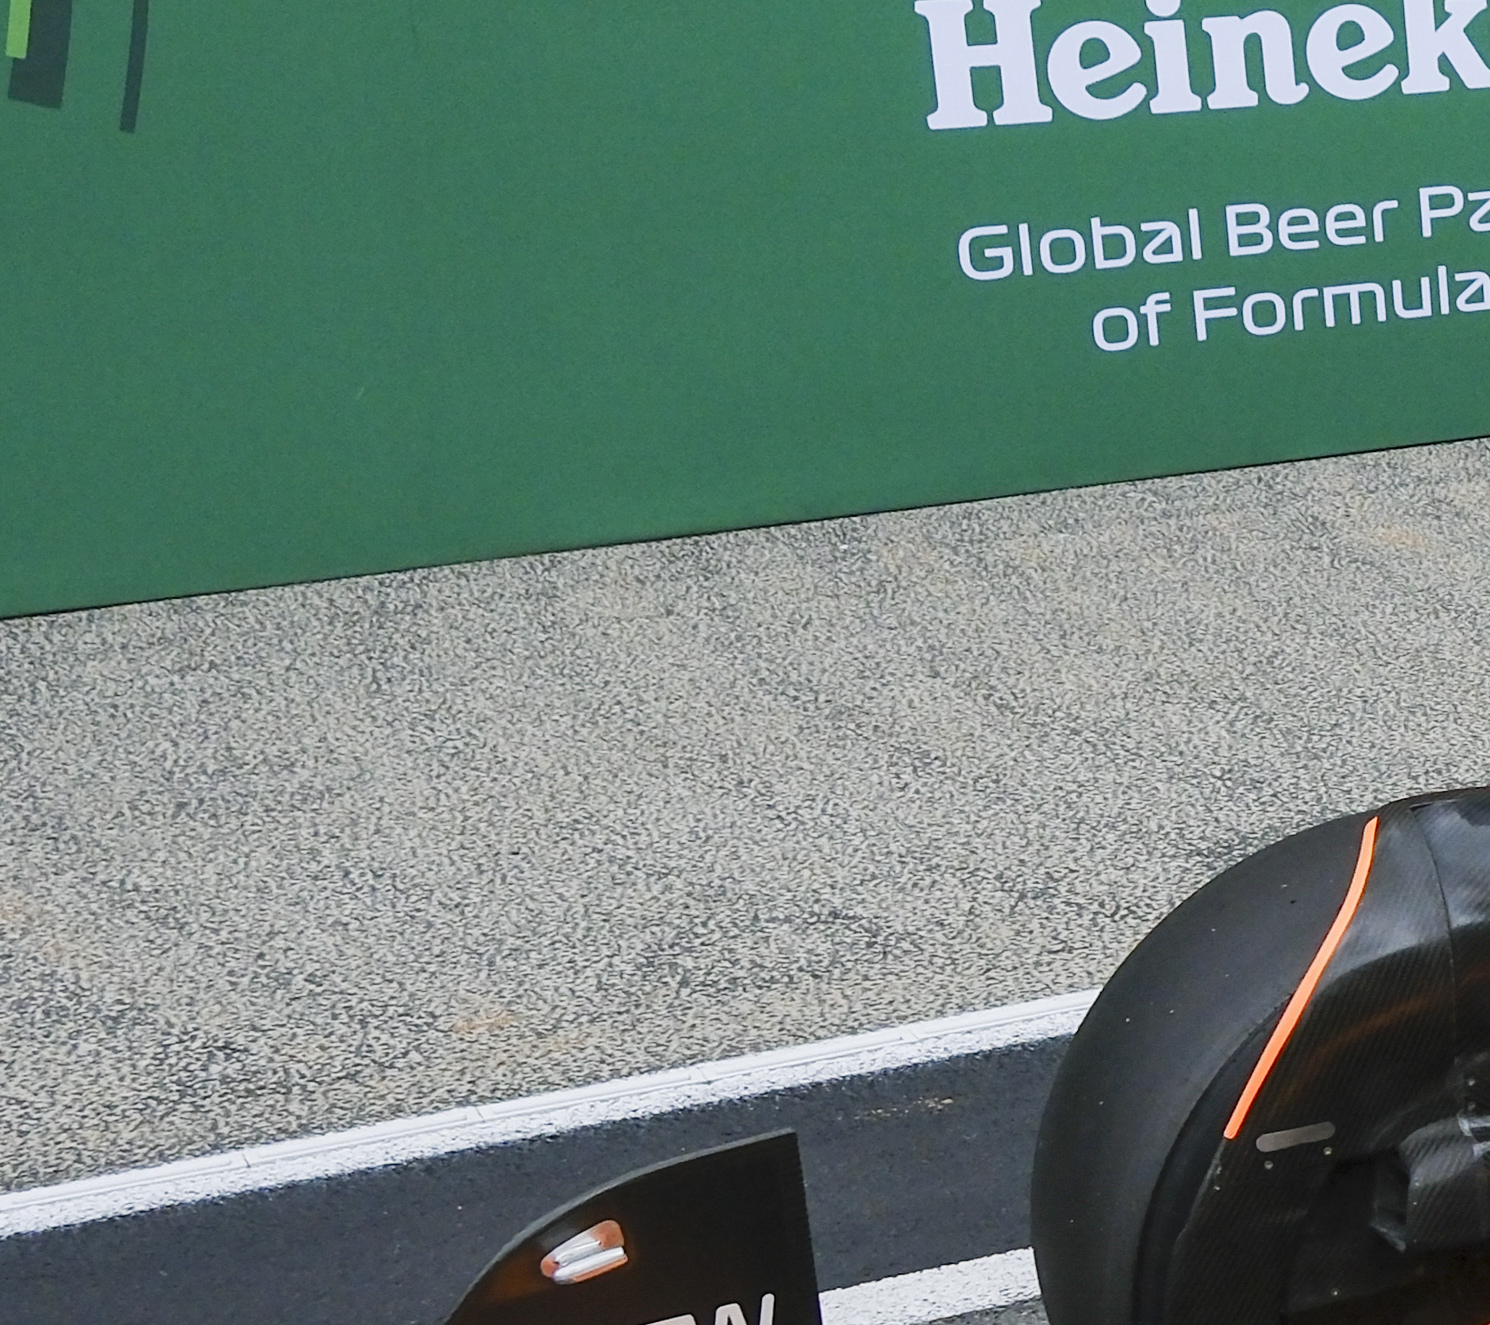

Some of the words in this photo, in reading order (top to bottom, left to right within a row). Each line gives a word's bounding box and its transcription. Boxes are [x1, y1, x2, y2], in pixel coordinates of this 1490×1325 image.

[958, 208, 1201, 282] Global
[1226, 199, 1399, 257] Beer
[1092, 293, 1172, 352] of
